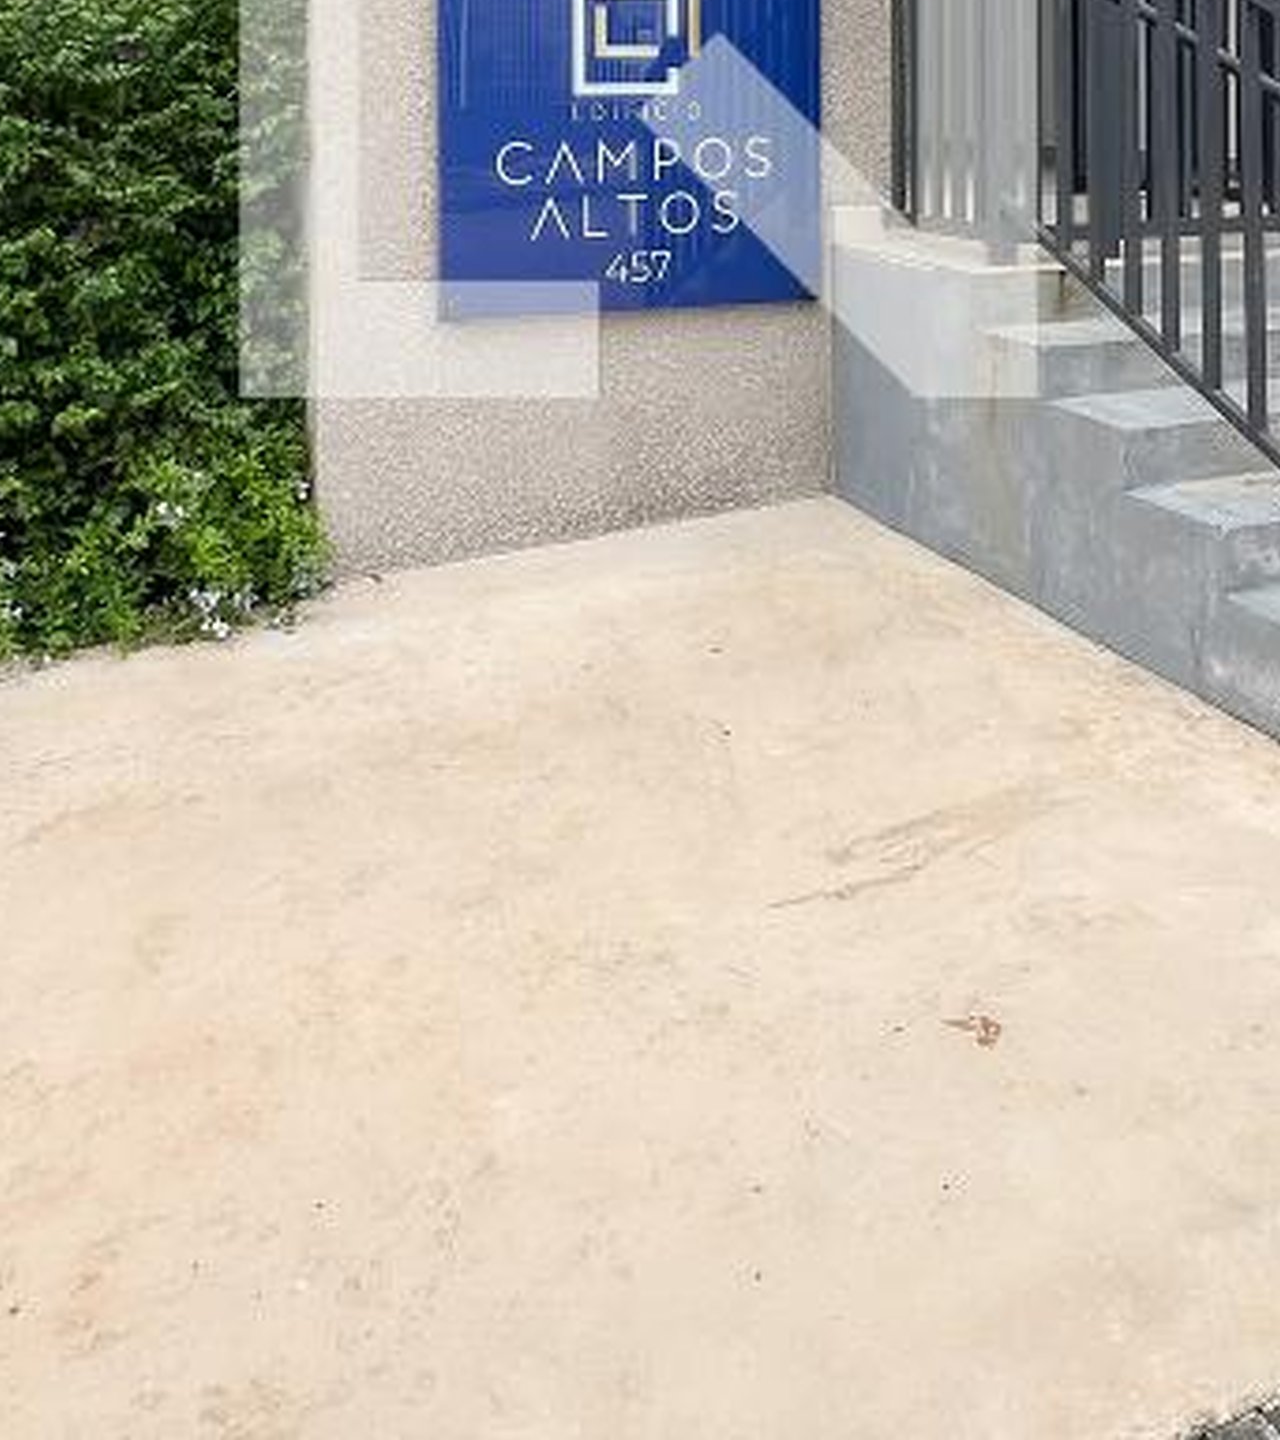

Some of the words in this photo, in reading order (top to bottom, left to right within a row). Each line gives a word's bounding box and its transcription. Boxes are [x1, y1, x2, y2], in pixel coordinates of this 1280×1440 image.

[496, 137, 773, 185] CAMPOS
[530, 191, 740, 241] ALTOS
[606, 250, 672, 283] 457
